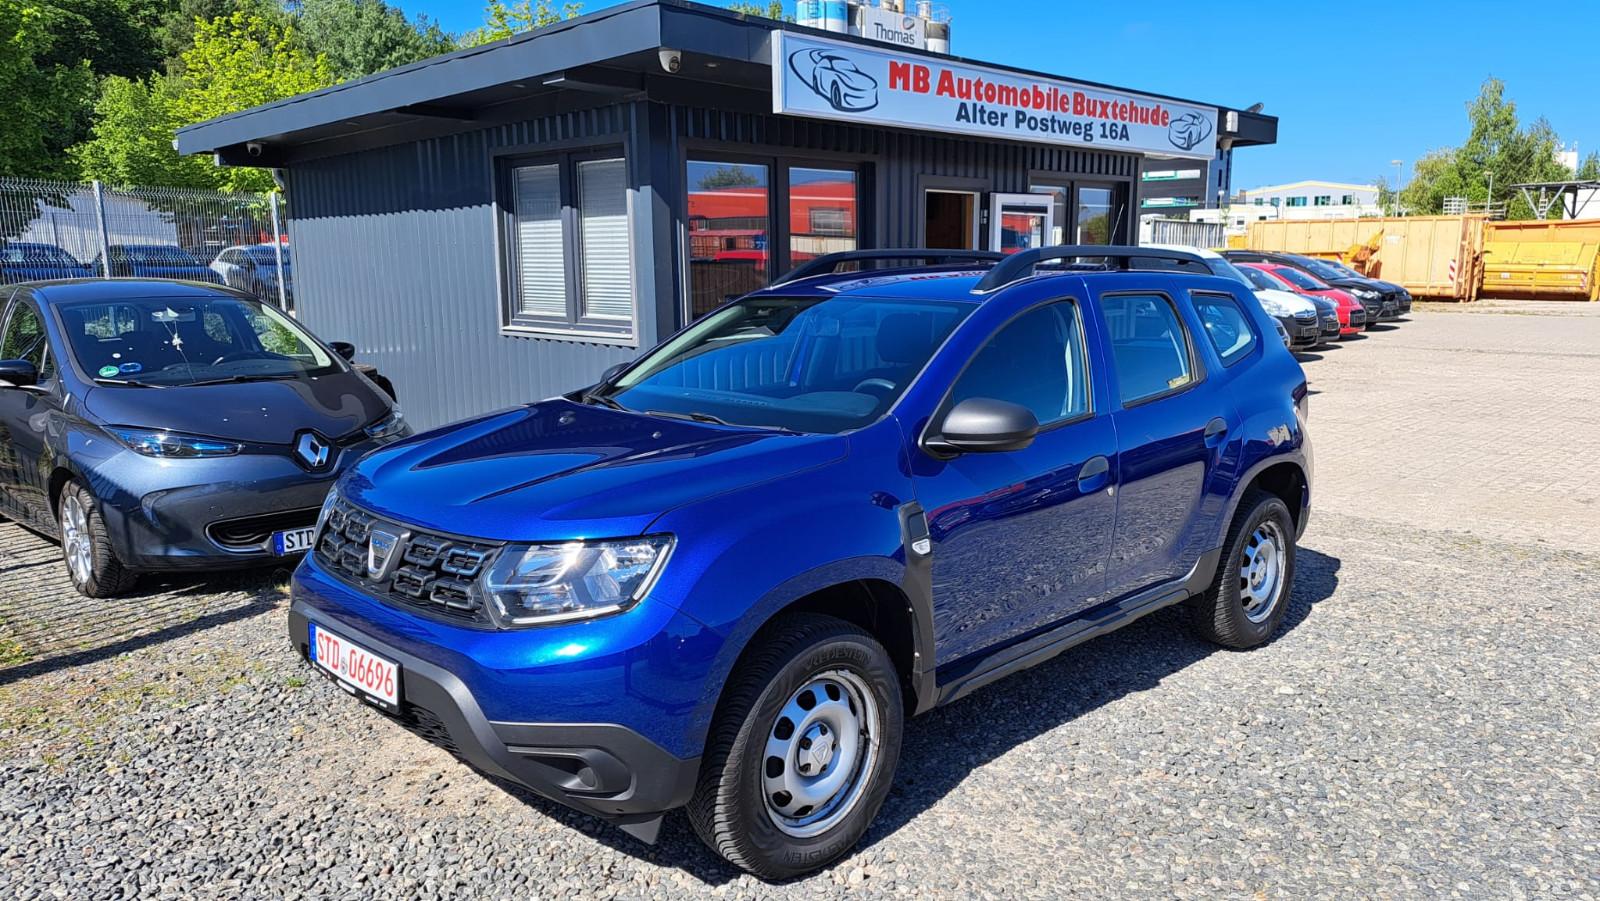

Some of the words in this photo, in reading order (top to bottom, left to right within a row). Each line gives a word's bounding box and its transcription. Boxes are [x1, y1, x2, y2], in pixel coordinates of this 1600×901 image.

[874, 22, 915, 45] Thomas
[889, 60, 930, 93] MB
[936, 69, 1070, 113] Automobile
[1072, 91, 1169, 127] Buxtehude
[955, 102, 1008, 127] Alter
[1015, 109, 1094, 141] Postweg
[1099, 121, 1130, 141] 16A
[317, 631, 340, 671] STD
[349, 648, 394, 697] 06696
